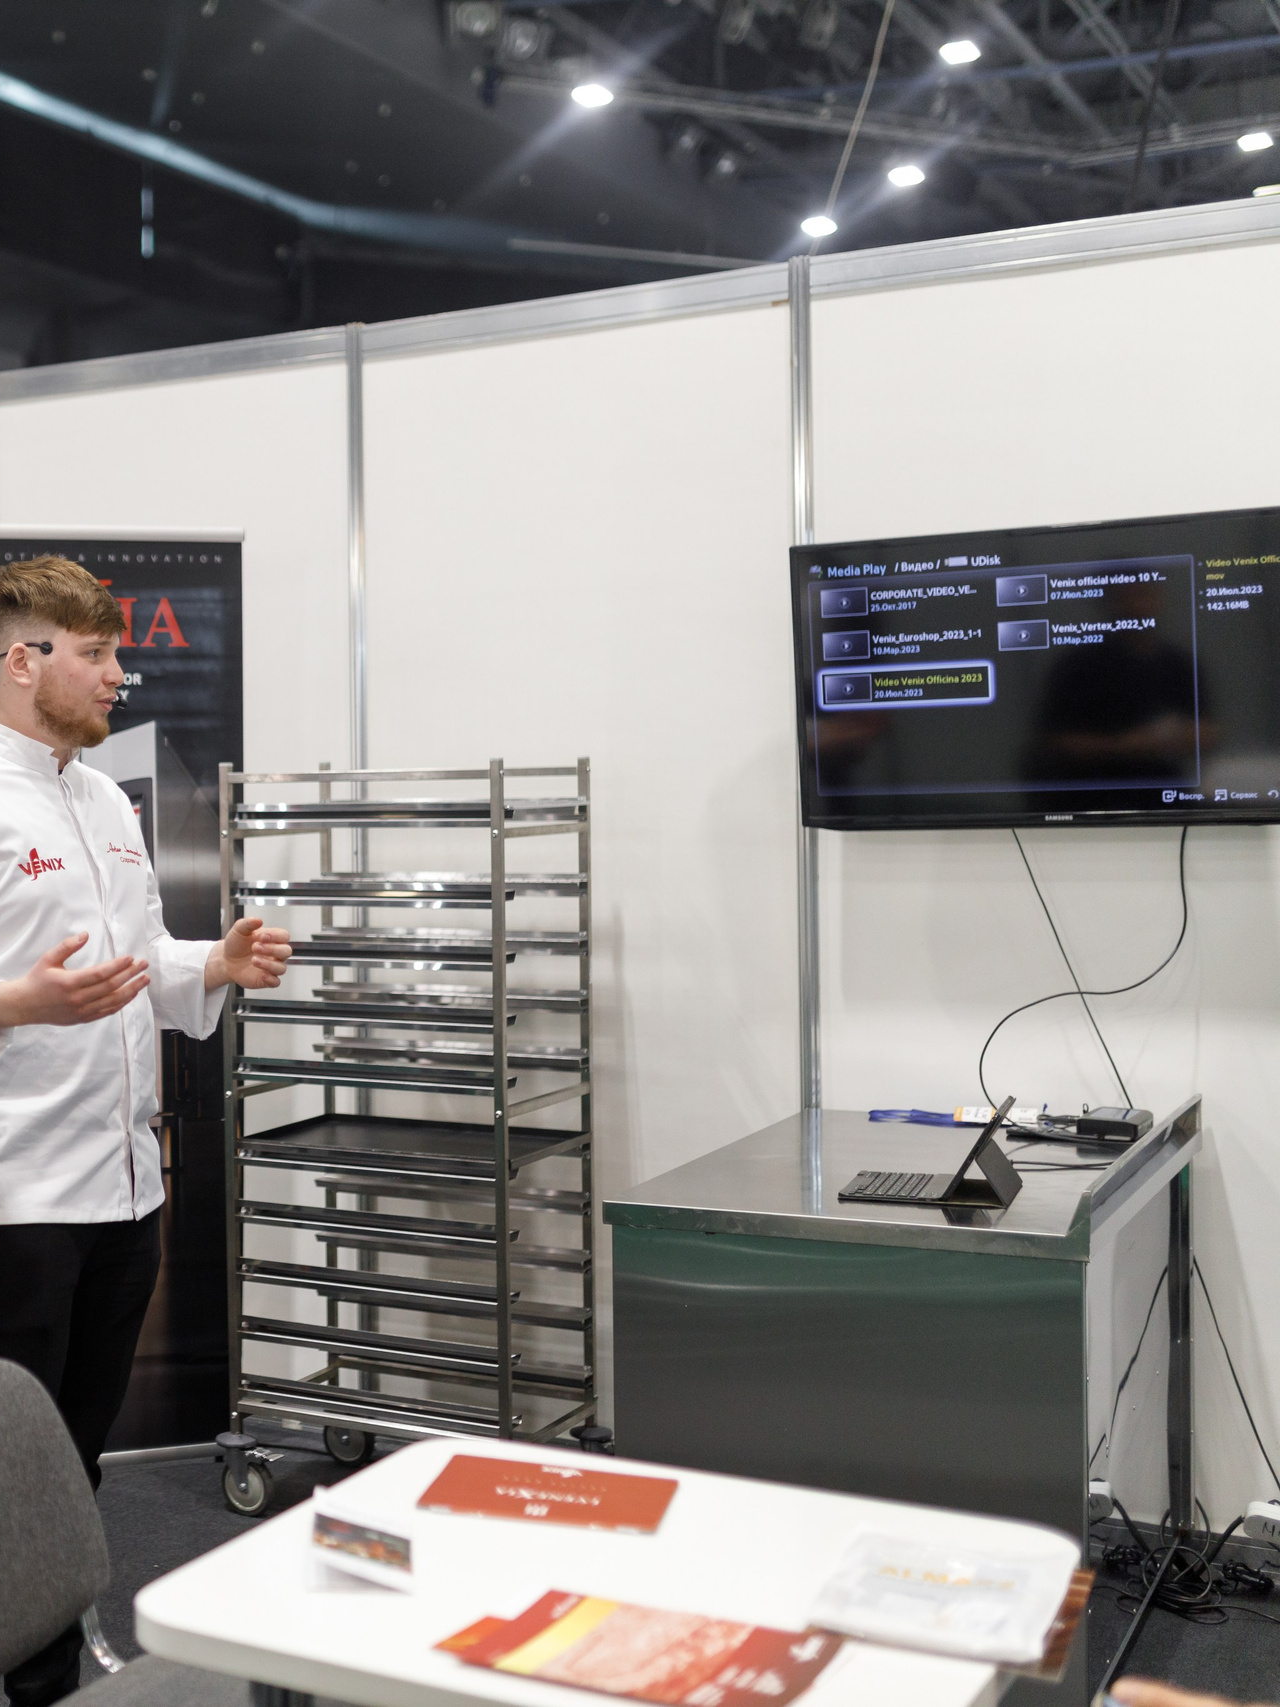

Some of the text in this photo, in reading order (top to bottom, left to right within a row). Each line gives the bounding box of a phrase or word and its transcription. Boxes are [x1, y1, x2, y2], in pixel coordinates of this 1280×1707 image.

[97, 554, 222, 564] INNOVATION
[827, 565, 861, 578] Media
[863, 563, 887, 576] Play
[901, 561, 934, 573] Видео
[970, 554, 1001, 567] UDisk
[1205, 559, 1231, 568] Video
[1233, 557, 1258, 566] Venix
[1050, 578, 1076, 589] Venix
[1077, 575, 1109, 587] official
[1110, 573, 1136, 585] video
[1138, 572, 1150, 583] 10
[123, 673, 142, 686] OR
[874, 673, 983, 687] Video Venix Officina 2023
[18, 848, 65, 881] VENIX
